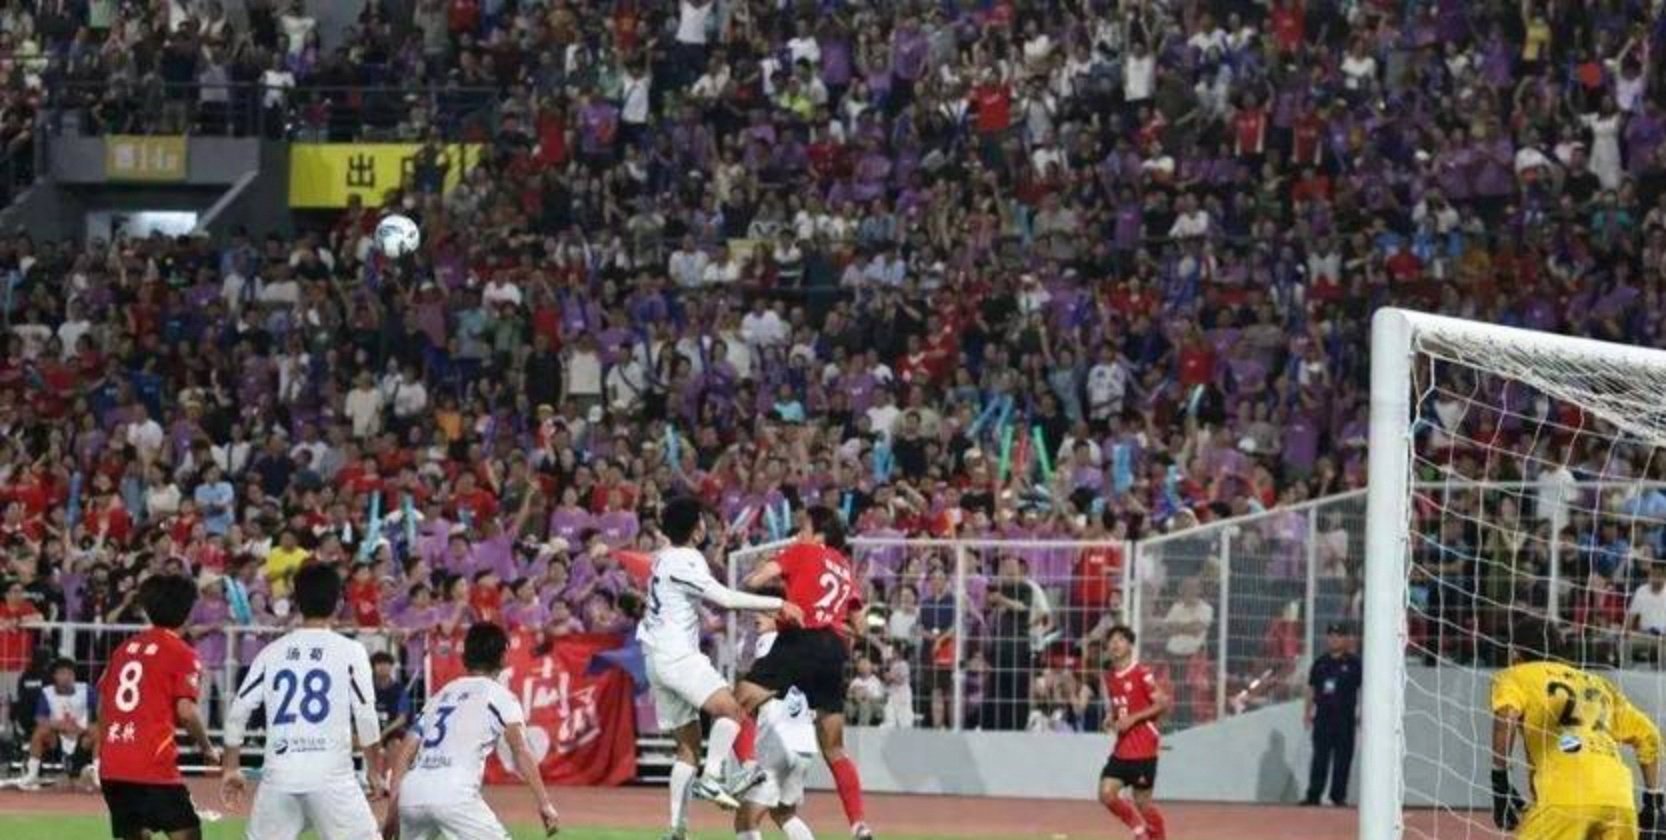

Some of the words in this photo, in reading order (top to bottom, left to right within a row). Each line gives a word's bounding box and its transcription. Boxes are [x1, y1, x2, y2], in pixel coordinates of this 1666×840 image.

[115, 661, 143, 713] 8
[273, 668, 332, 725] 28
[424, 706, 456, 748] 3
